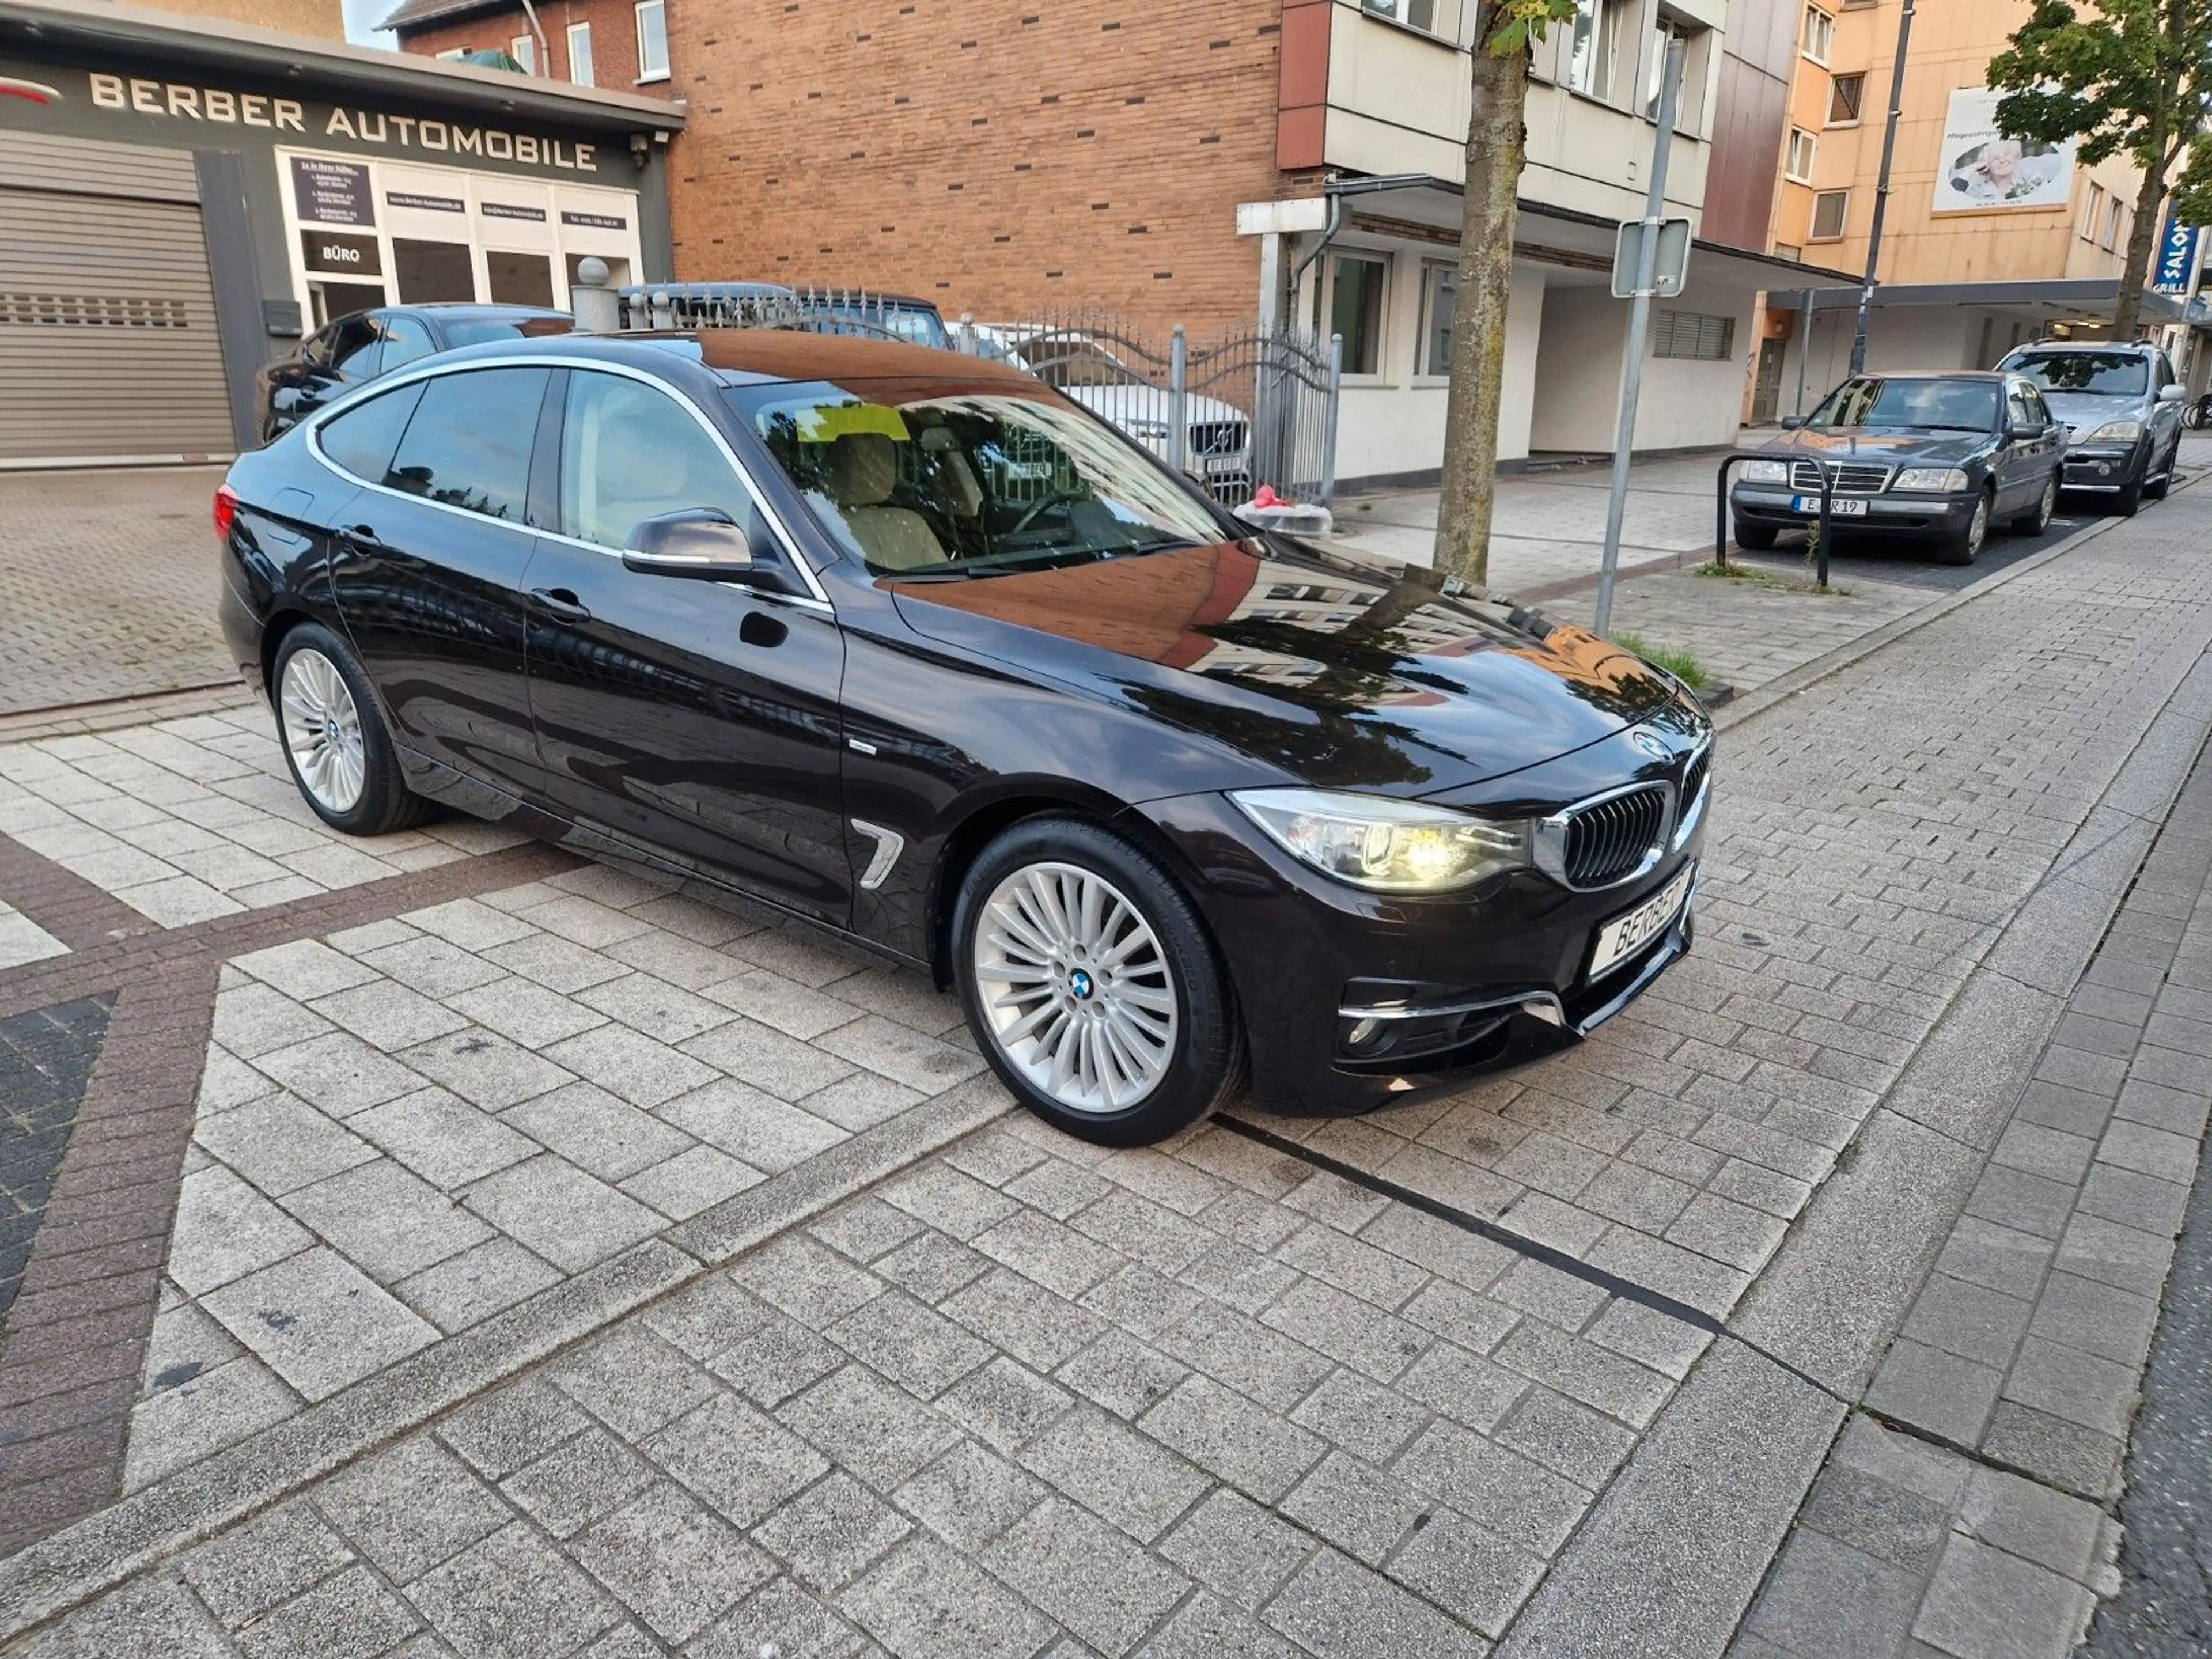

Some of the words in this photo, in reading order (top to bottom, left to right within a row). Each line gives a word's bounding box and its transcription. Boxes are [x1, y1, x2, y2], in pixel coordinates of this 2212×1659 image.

[90, 73, 306, 132] BERBER
[325, 108, 597, 171] AUTOMOBILE
[323, 245, 361, 263] BÜRO
[2153, 283, 2186, 294] GRILL
[1808, 499, 1815, 510] E
[1842, 501, 1858, 512] 19
[1613, 880, 1681, 956] BERBER
